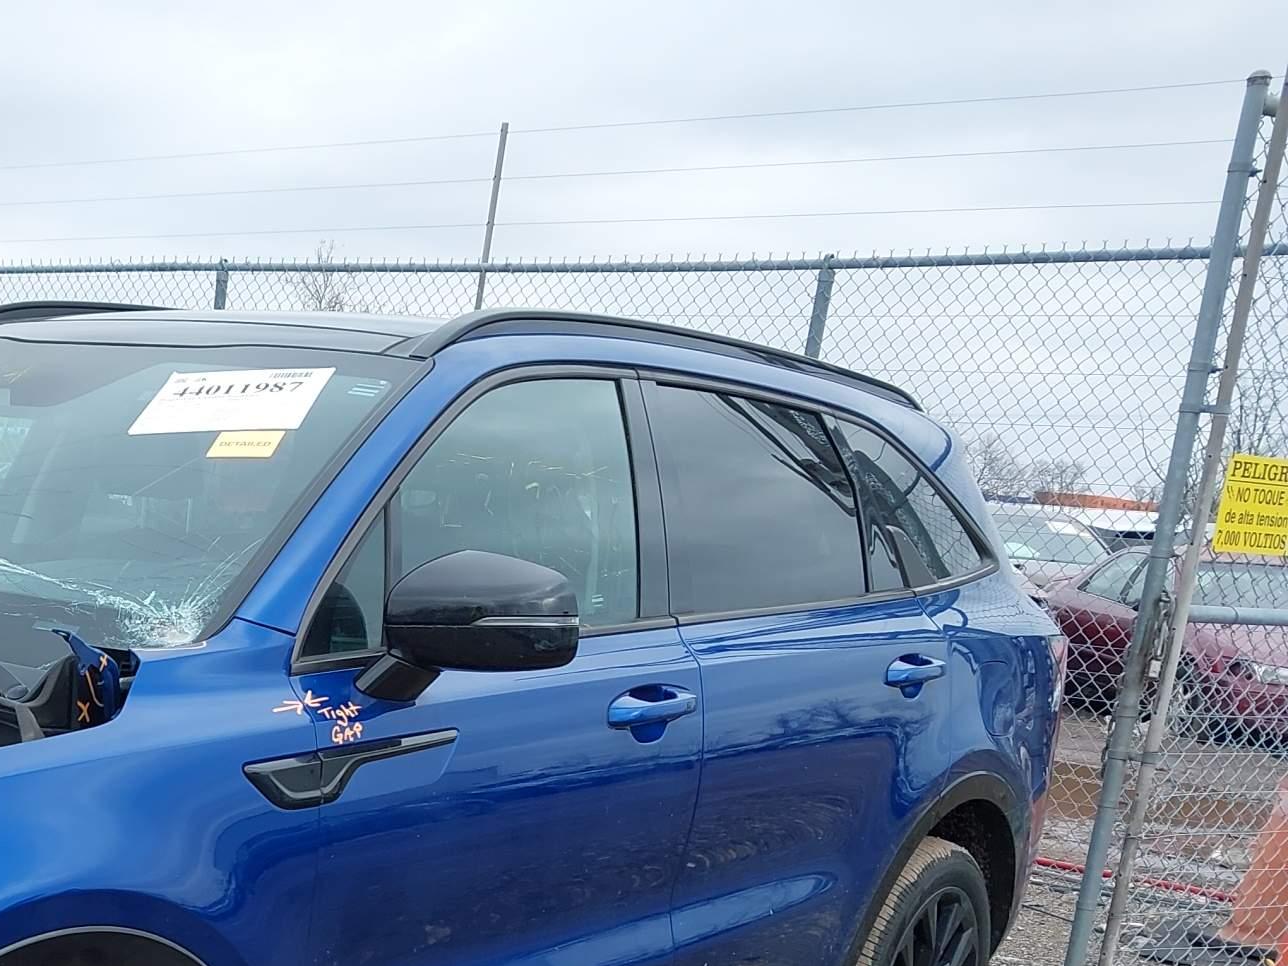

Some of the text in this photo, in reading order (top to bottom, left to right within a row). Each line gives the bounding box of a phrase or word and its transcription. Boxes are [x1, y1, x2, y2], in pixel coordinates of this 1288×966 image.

[173, 380, 304, 398] 44011987
[1230, 460, 1288, 482] PELIGR
[1235, 487, 1286, 506] NO TOQUE
[1225, 508, 1237, 524] de
[1238, 509, 1255, 525] alta
[1216, 529, 1241, 547] 7.000
